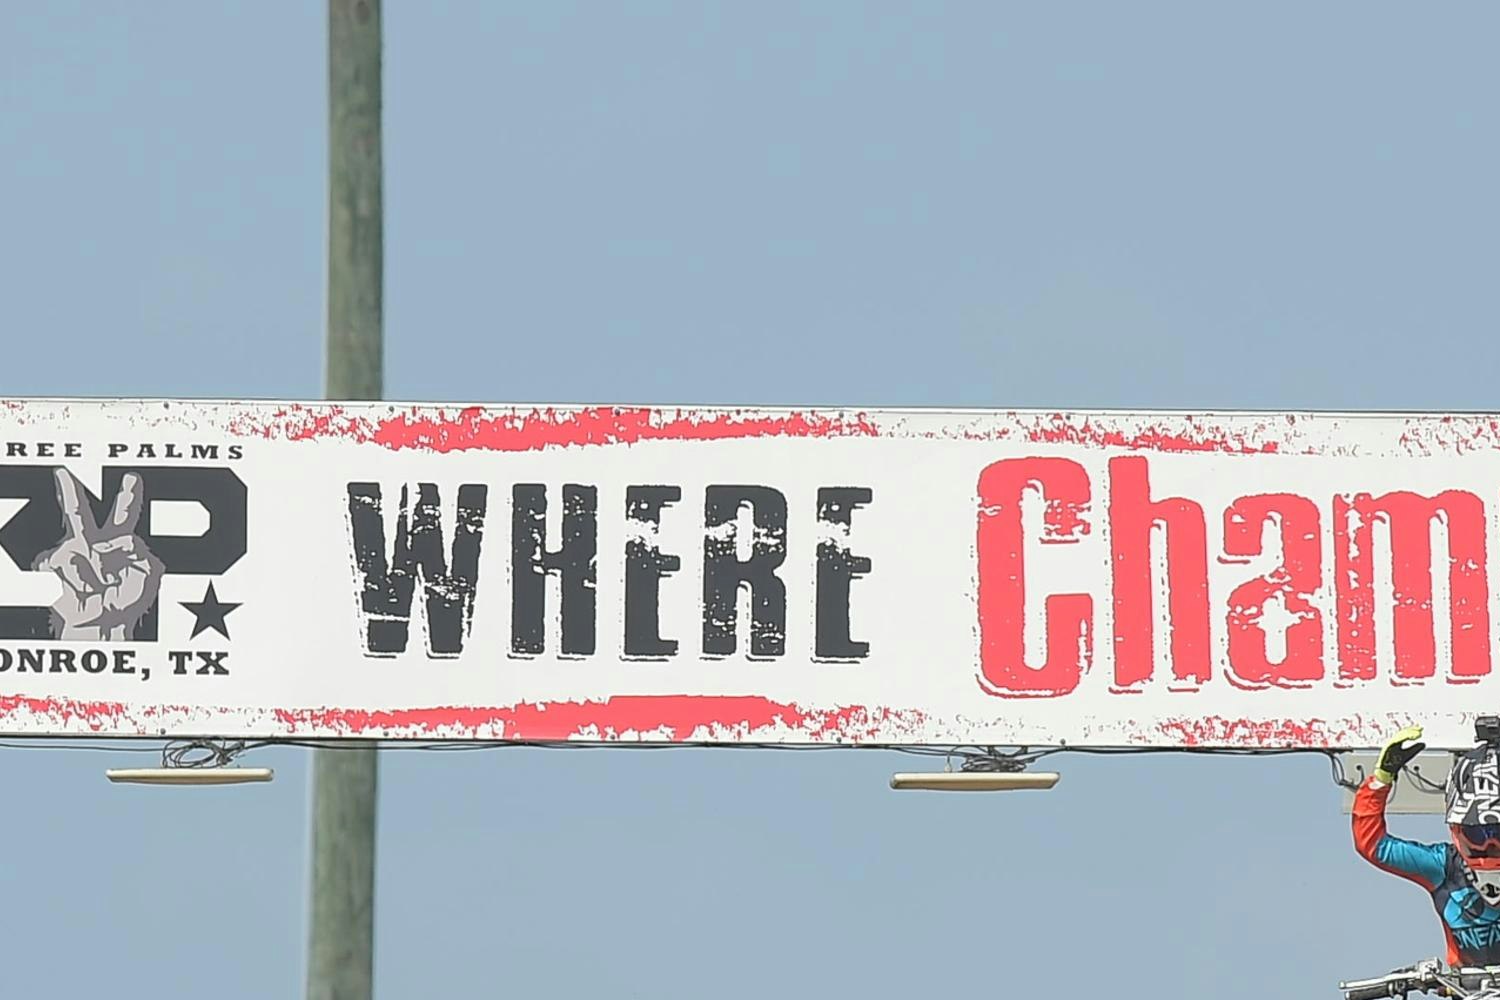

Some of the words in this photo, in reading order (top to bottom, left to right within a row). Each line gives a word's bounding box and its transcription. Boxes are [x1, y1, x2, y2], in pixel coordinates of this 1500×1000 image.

[108, 443, 243, 460] PALMS
[345, 482, 873, 662] WHERE
[168, 650, 230, 676] TX
